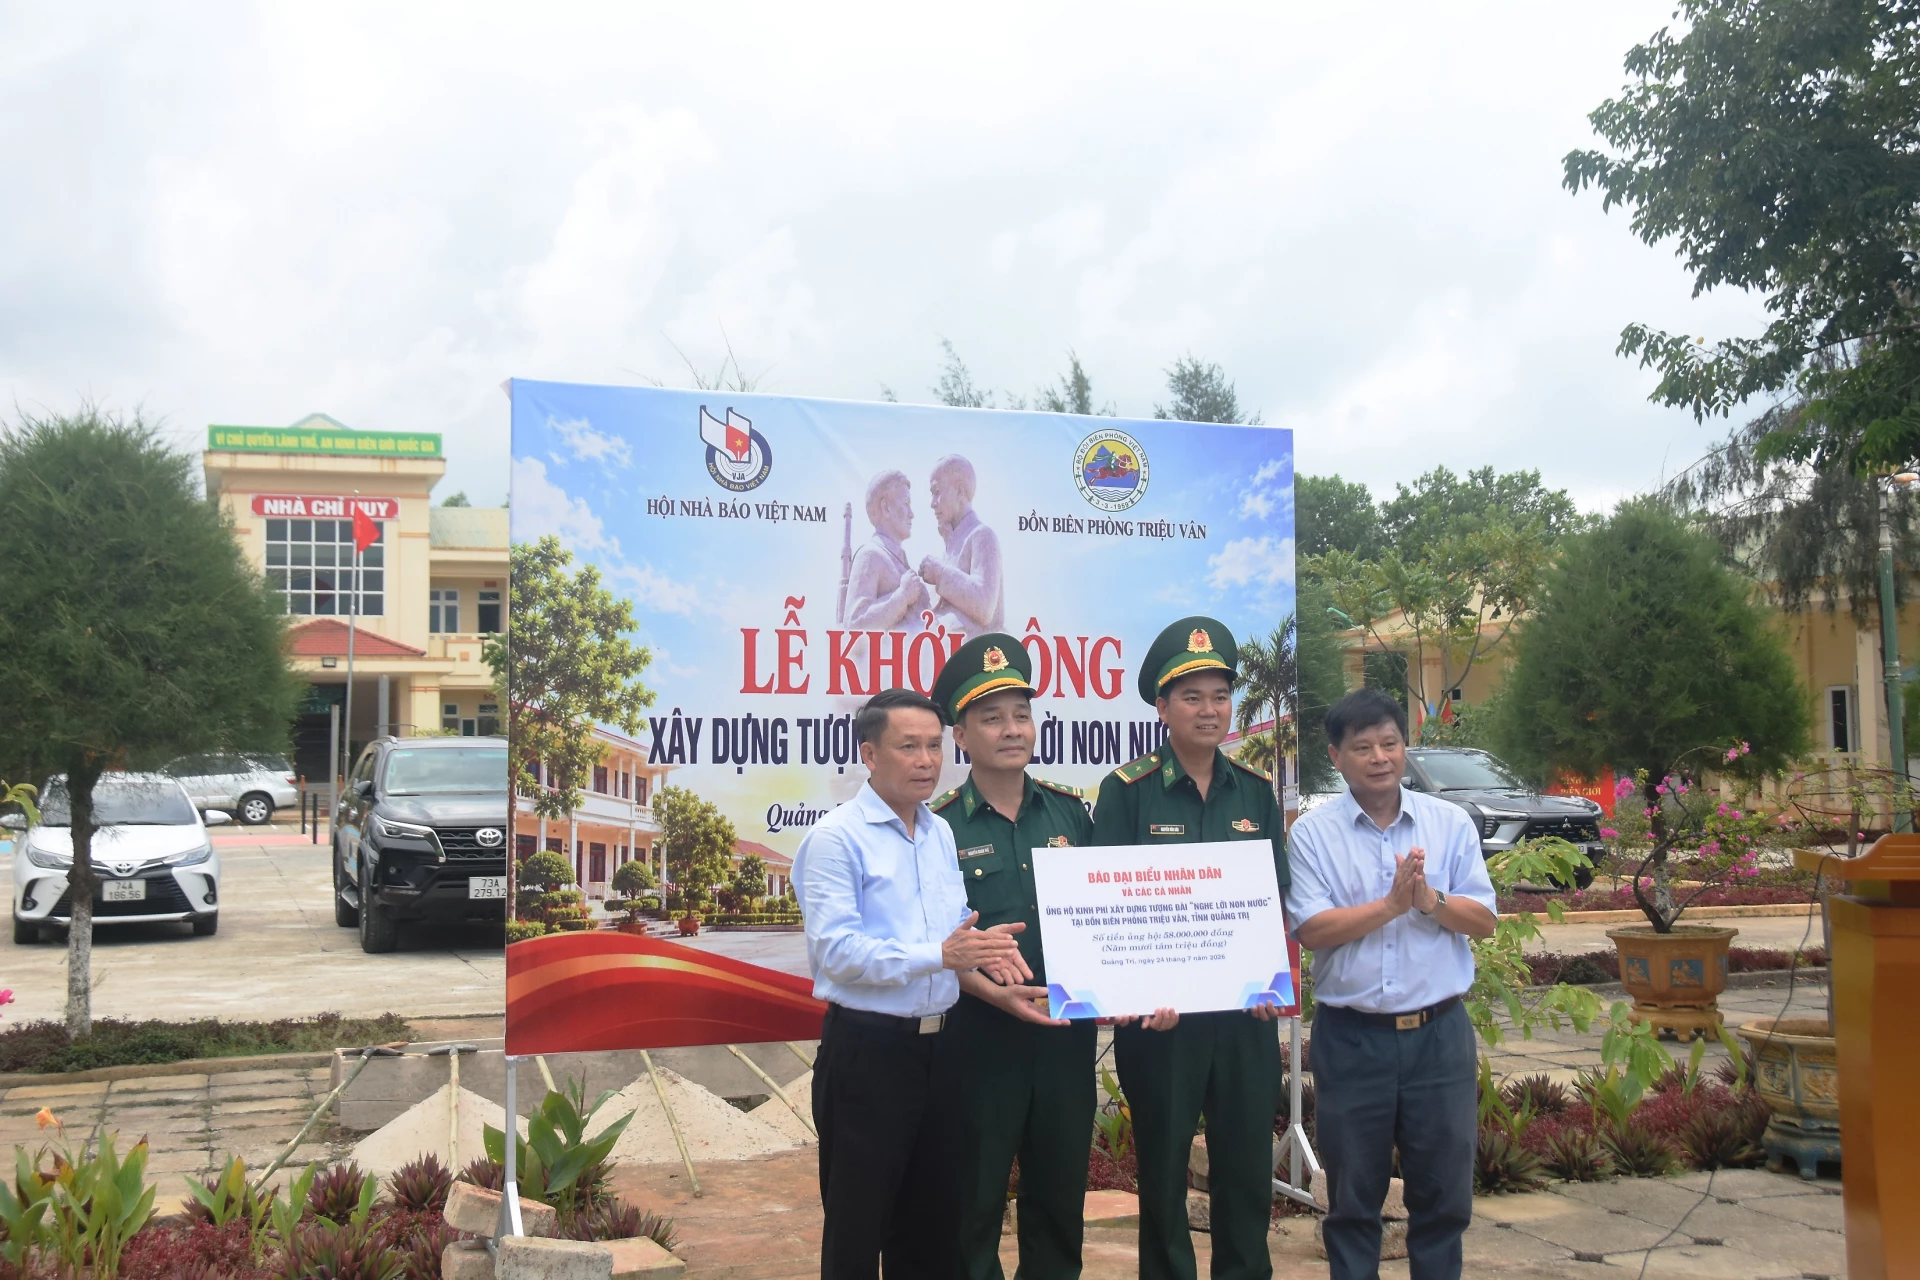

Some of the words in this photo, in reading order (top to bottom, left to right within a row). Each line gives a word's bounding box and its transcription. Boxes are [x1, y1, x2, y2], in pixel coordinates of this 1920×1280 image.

[1139, 452, 1148, 468] NAM
[731, 472, 746, 480] VJA
[759, 465, 770, 480] NAM
[263, 496, 307, 515] NHÀ
[647, 495, 675, 519] HỘI
[679, 496, 713, 517] NHÀ
[718, 497, 750, 519] BÁO
[755, 500, 789, 524] VIỆT
[793, 505, 827, 522] NAM
[1018, 509, 1048, 532] ĐỒN
[1053, 514, 1084, 534] BIÊN
[1088, 516, 1133, 536] PHÒNG
[1137, 519, 1175, 541] TRIỆU
[1179, 520, 1207, 539] VÂN
[740, 595, 811, 695] LỄ
[1020, 617, 1125, 699] ÔNG
[648, 707, 703, 764] XÂY
[712, 713, 788, 774] DỰNG
[1072, 720, 1121, 764] NON
[481, 878, 500, 888] 73A
[1088, 870, 1111, 884] BÁO
[1113, 871, 1132, 884] ĐẠI
[1135, 866, 1161, 882] BIỂU
[1164, 867, 1195, 881] NHÂN
[1198, 866, 1222, 879] DÂN
[115, 881, 133, 890] 74A
[1122, 887, 1133, 897] VÀ
[1135, 886, 1152, 896] CÁC
[1155, 886, 1166, 896] CÁ
[1168, 885, 1192, 895] NHÂN
[1046, 905, 1062, 915] ỦNG
[1064, 906, 1074, 916] HỘ
[1076, 906, 1094, 915] KINH
[1096, 905, 1108, 914] PHÍ
[1110, 904, 1124, 914] XÂY
[1127, 904, 1147, 914] DỰNG
[1149, 903, 1173, 913] TƯỢNG
[1175, 902, 1188, 912] ĐÀI
[1216, 900, 1227, 909] LỜI
[1229, 900, 1245, 908] NON
[1071, 918, 1083, 928] TẠI
[1103, 916, 1120, 926] BIÊN
[1122, 916, 1148, 925] PHÒNG
[1149, 914, 1170, 925] TRIỆU
[1172, 913, 1190, 923] VÂN,
[1191, 912, 1208, 922] TỈNH
[1210, 911, 1236, 921] QUẢNG
[1238, 911, 1250, 920] TRỊ
[1092, 932, 1105, 941] Số
[1163, 930, 1208, 939] 58.000.000
[1211, 928, 1234, 937] đồng
